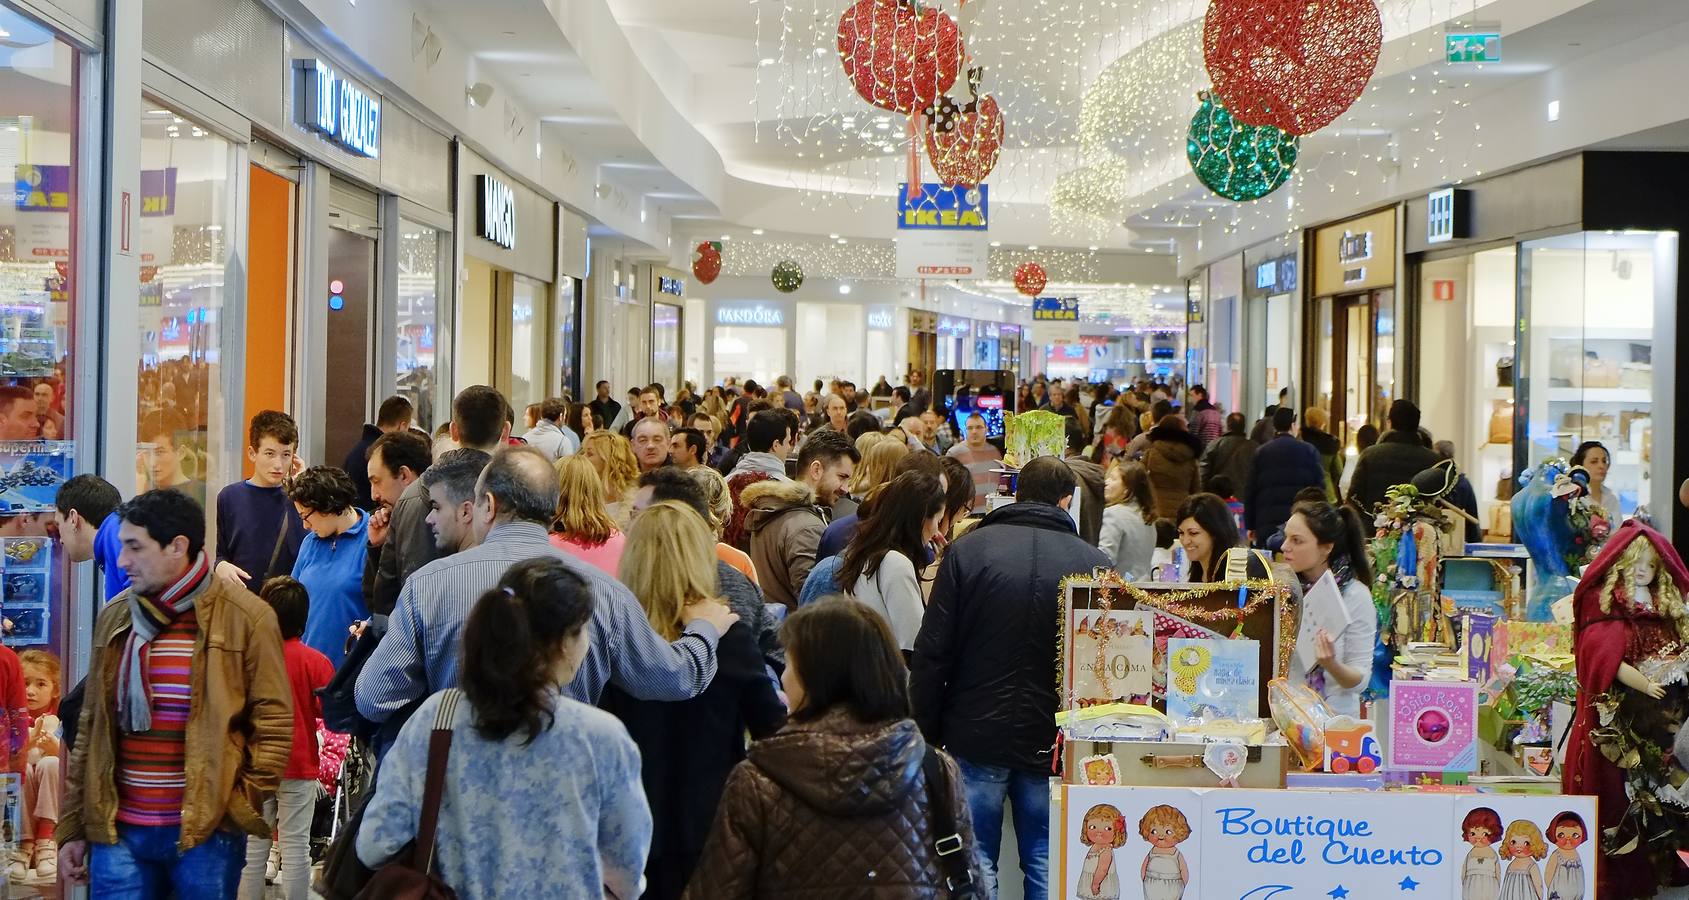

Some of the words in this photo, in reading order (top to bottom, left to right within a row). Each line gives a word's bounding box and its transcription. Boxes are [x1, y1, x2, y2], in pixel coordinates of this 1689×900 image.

[315, 58, 336, 135] TINO
[340, 79, 379, 159] GONZALEZ
[484, 173, 515, 250] MANGO
[905, 209, 982, 226] IKEA
[1034, 310, 1076, 320] IKEA
[1401, 694, 1431, 717] Osito
[1436, 691, 1463, 720] Rosa
[1215, 807, 1373, 842] Boutique
[1247, 838, 1306, 865] del
[1322, 840, 1443, 866] Cuento
